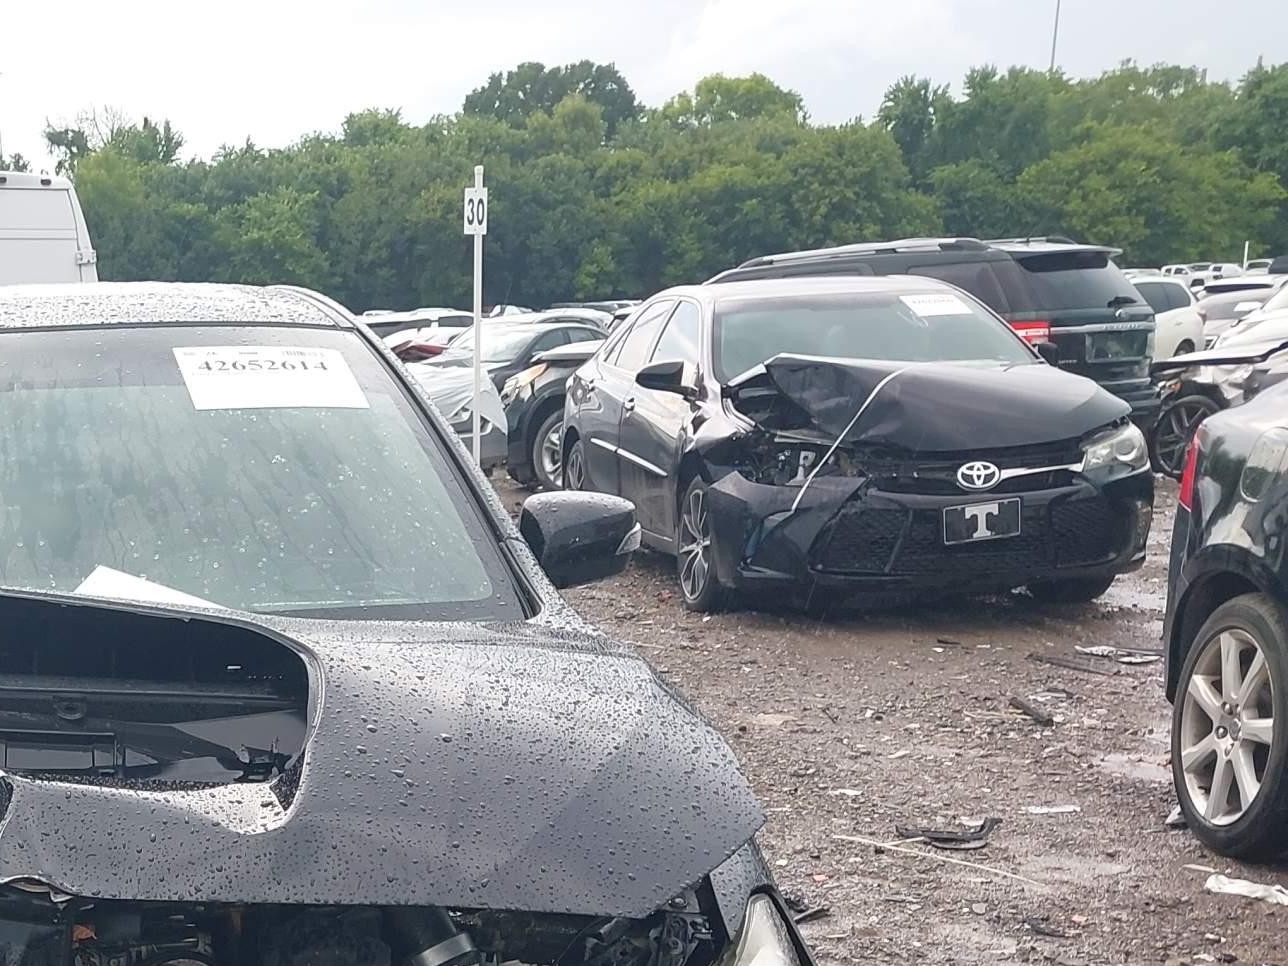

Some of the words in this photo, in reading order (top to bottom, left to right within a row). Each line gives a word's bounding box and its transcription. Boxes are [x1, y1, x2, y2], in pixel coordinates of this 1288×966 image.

[467, 198, 485, 226] 30
[198, 359, 328, 371] 42652614
[965, 503, 999, 539] T
